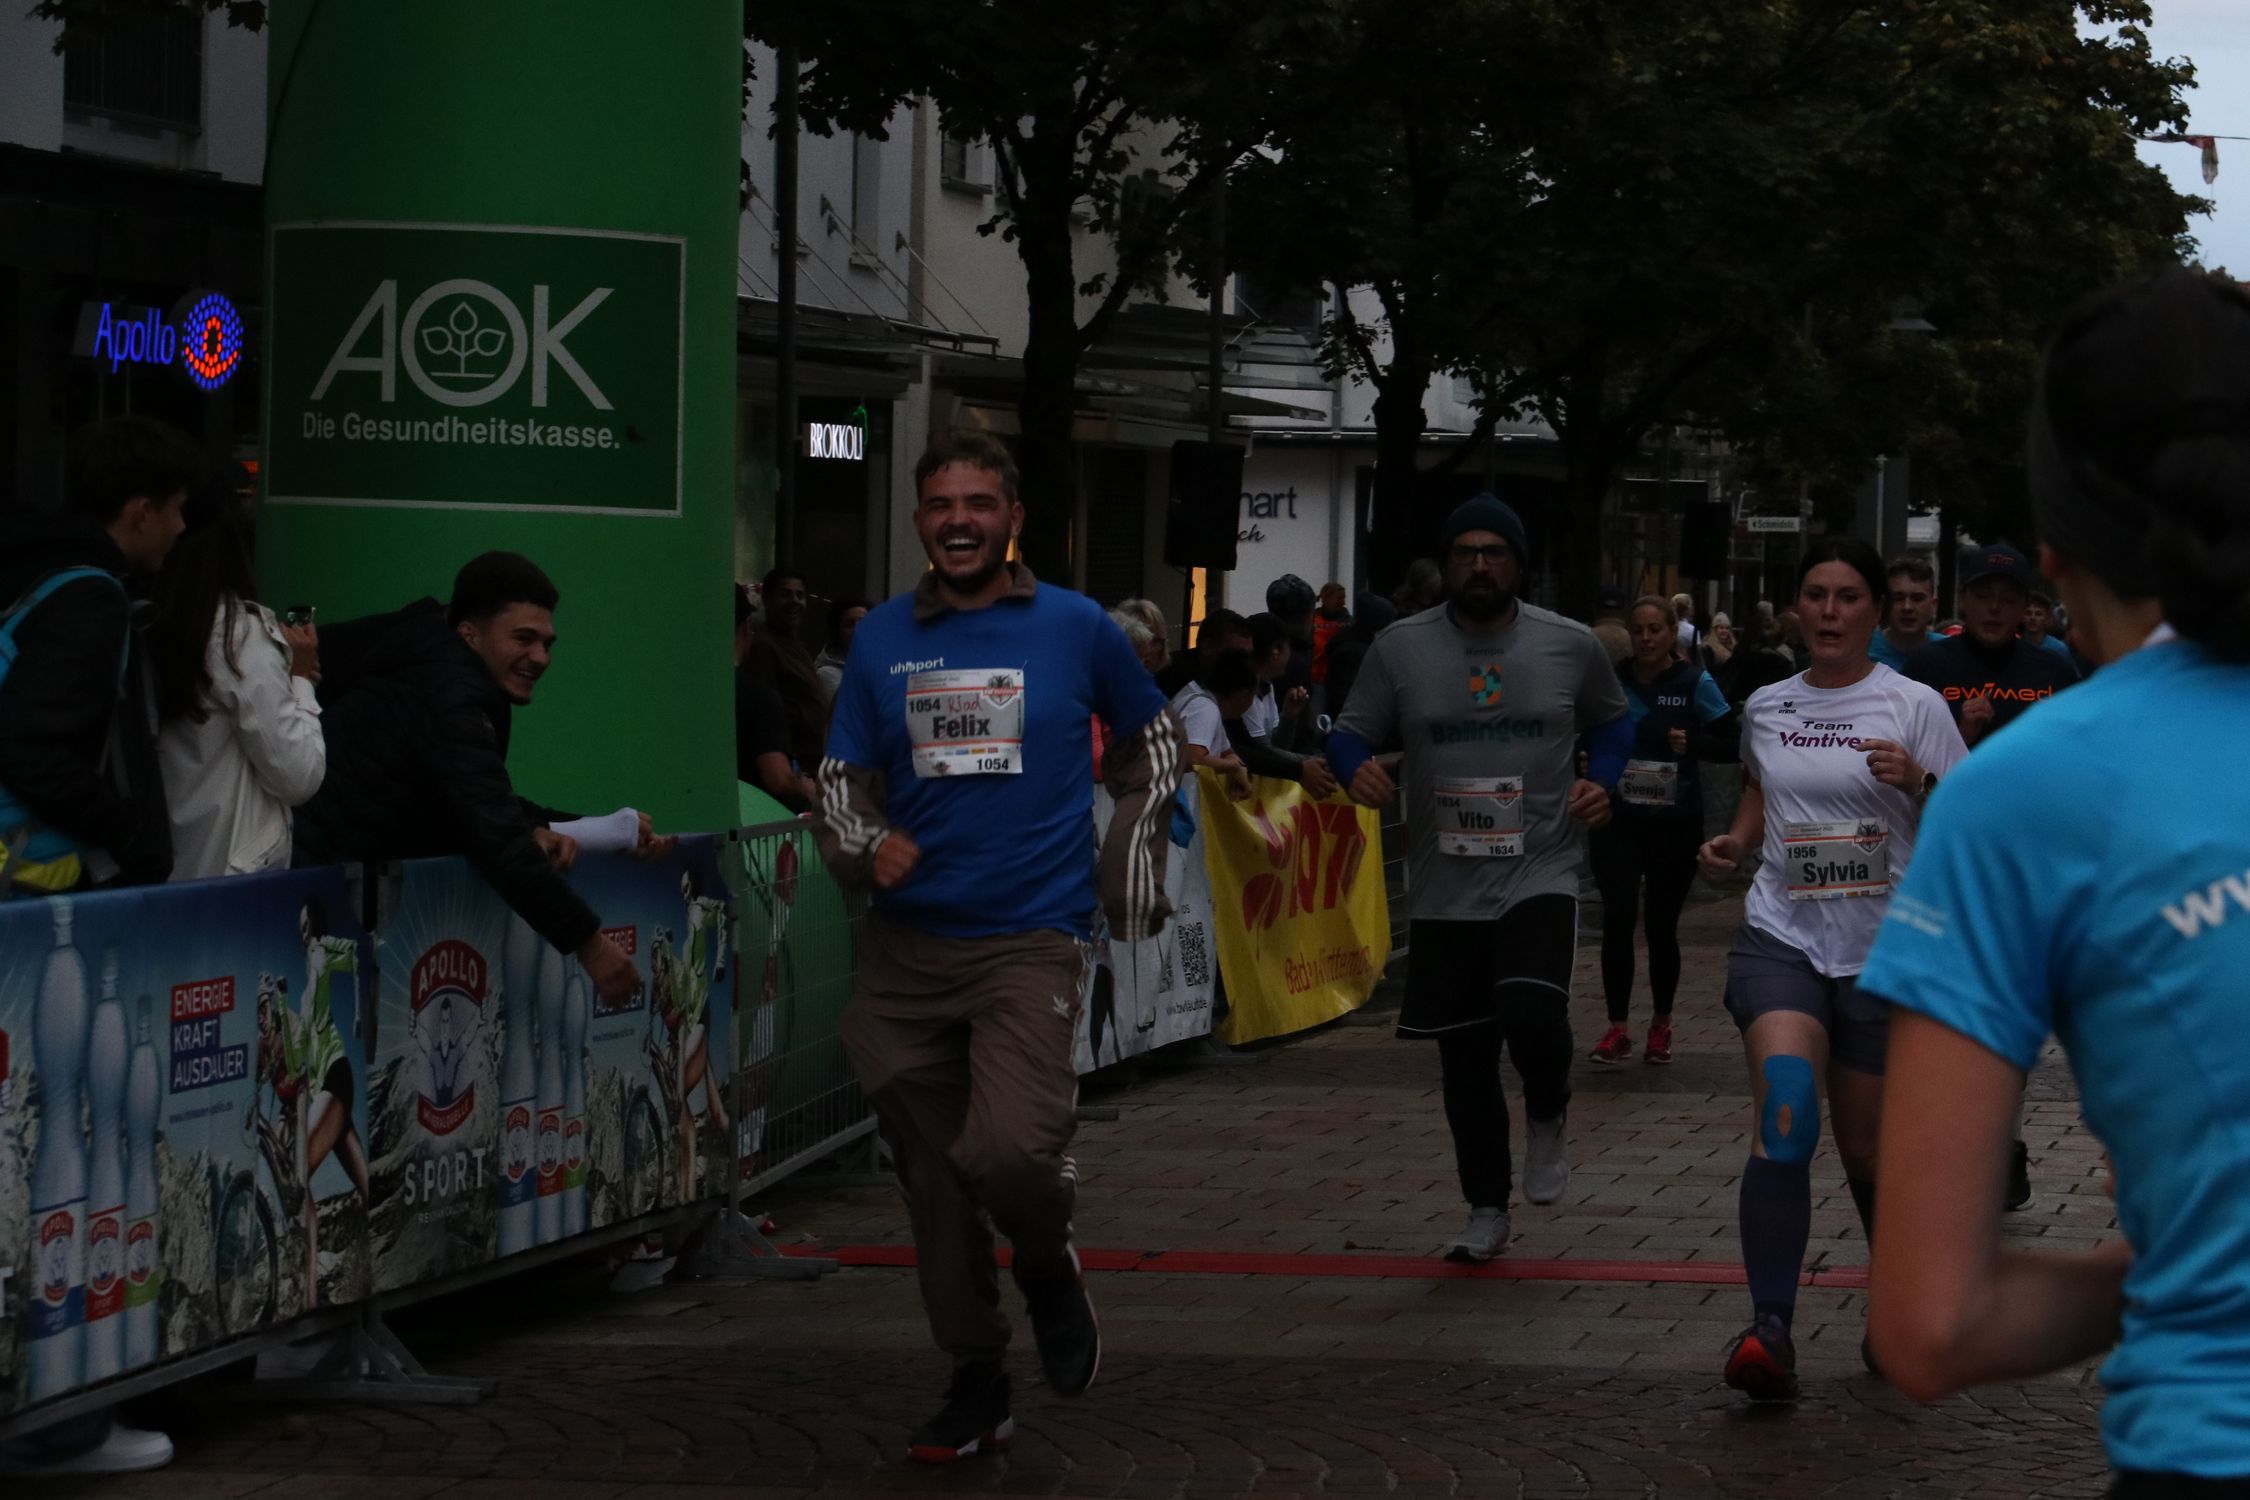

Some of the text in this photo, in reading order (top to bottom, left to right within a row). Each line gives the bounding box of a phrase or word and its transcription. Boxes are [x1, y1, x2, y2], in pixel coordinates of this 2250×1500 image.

[93, 302, 176, 373] Apollo
[310, 278, 615, 411] AOK
[303, 411, 620, 449] Die Gesundheitskasse.
[809, 422, 864, 460] BROKKOLI
[889, 656, 944, 675] uhlsport
[909, 698, 941, 713] 1054
[1657, 695, 1688, 708] RIDI
[932, 714, 991, 739] Felix
[1430, 719, 1544, 744] Balingen
[1802, 720, 1853, 731] Team
[1779, 731, 1861, 749] Vantive
[976, 758, 1009, 771] 1054
[1457, 811, 1495, 830] Vito
[1489, 844, 1515, 855] 1634
[1786, 846, 1817, 859] 1956
[1803, 860, 1869, 887] Sylvia
[417, 948, 480, 994] APOLLO
[174, 980, 231, 1018] ENERGIE
[173, 1018, 219, 1051] KRAFT
[172, 1050, 245, 1089] AUSDAUER
[403, 1147, 487, 1206] SPORT
